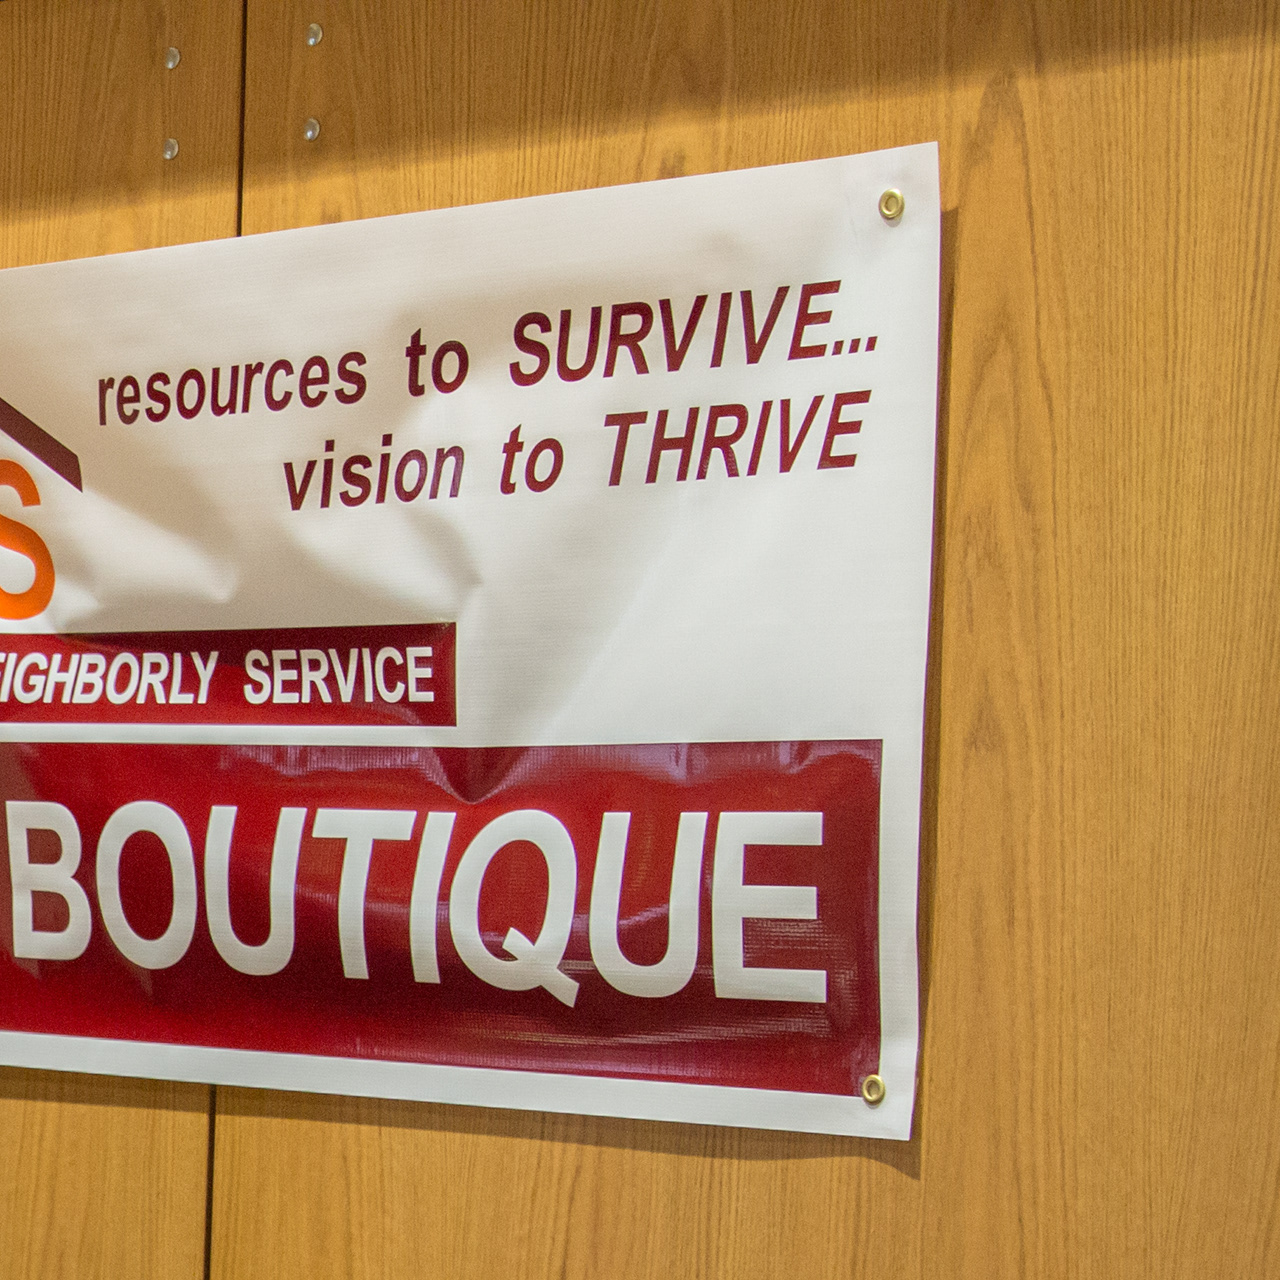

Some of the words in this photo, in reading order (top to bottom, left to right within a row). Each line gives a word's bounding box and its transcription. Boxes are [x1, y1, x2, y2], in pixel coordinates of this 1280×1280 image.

[97, 343, 367, 427] resources
[405, 328, 470, 395] to
[509, 278, 878, 386] SURVIVE...
[283, 433, 462, 510] vision
[498, 426, 564, 495] to
[602, 390, 871, 487] THRIVE
[243, 645, 436, 705] SERVICE
[5, 798, 828, 1008] BOUTIQUE
